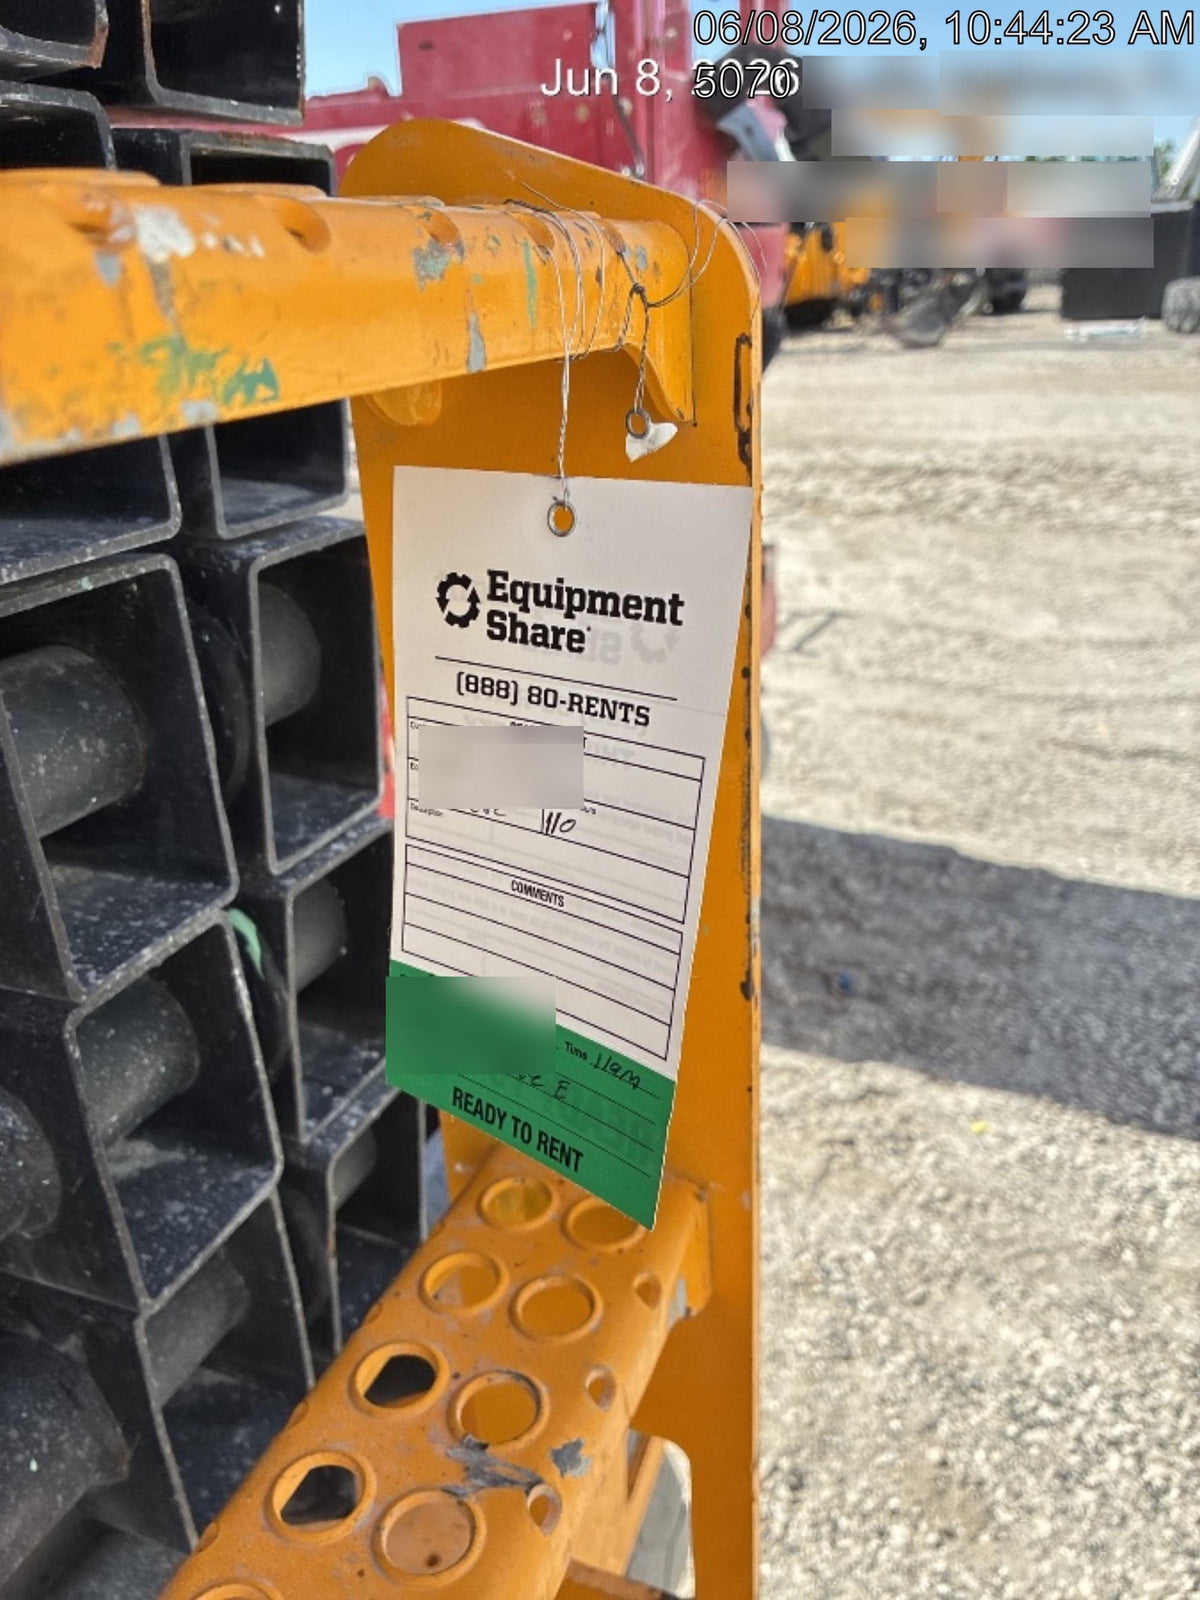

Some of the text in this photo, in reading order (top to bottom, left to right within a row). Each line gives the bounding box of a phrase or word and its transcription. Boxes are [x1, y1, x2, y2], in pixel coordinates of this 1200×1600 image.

[486, 569, 685, 626] Equipment
[486, 610, 587, 654] Share
[456, 671, 651, 728] (888) 80-RENTS
[510, 879, 565, 908] COMMENTS
[564, 1041, 588, 1061] Time
[452, 1086, 584, 1173] READY TO RENT
